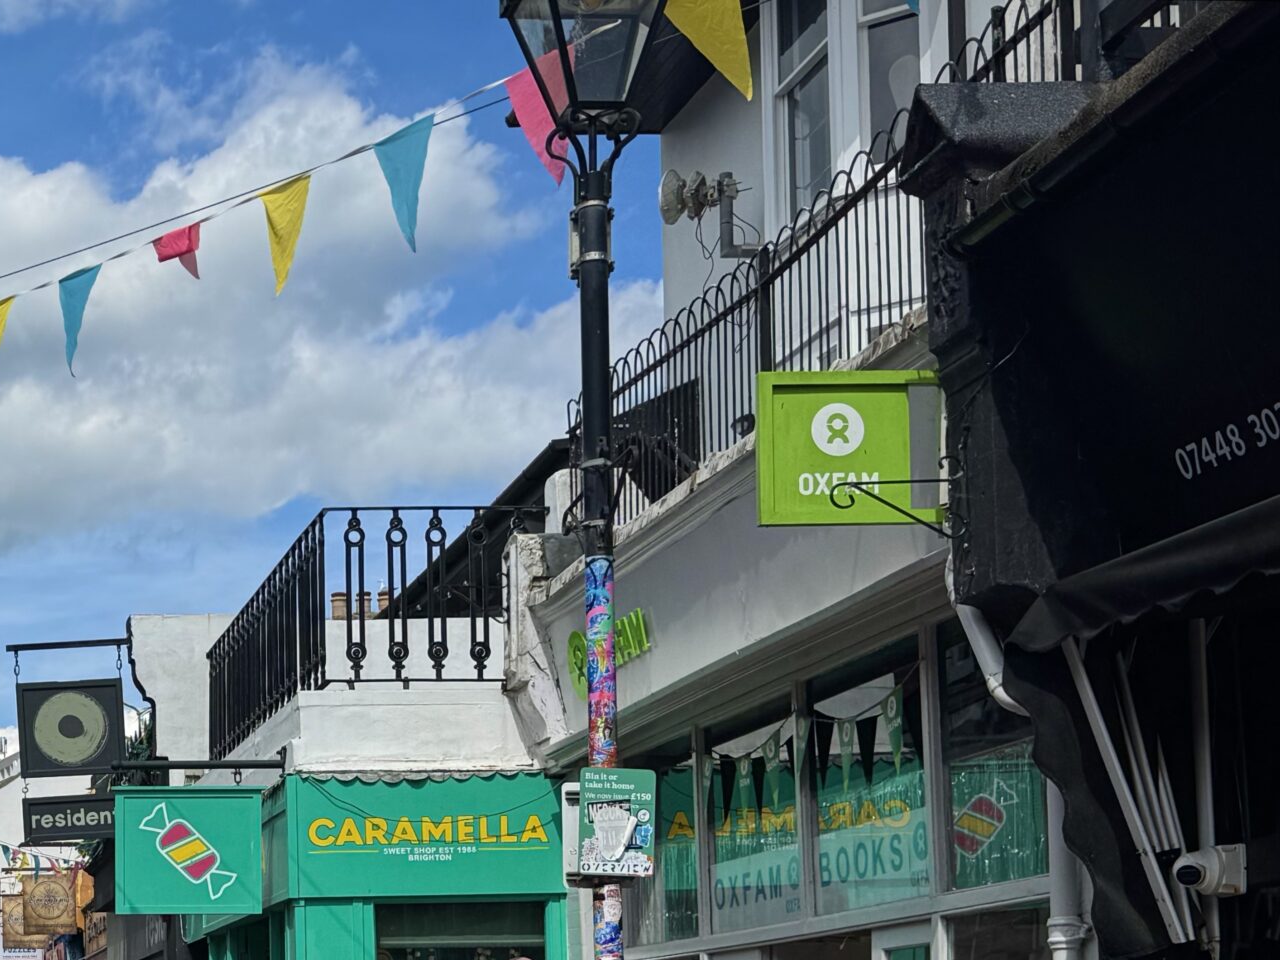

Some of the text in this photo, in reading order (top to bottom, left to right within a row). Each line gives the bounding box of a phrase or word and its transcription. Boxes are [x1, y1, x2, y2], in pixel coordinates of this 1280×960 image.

[1175, 423, 1246, 480] 07448
[798, 471, 879, 496] OXFAM
[585, 772, 600, 780] Bin
[612, 782, 635, 790] home
[31, 808, 115, 829] residen
[307, 814, 549, 847] CARAMELLA
[713, 833, 904, 911] OXFAM BOOKS
